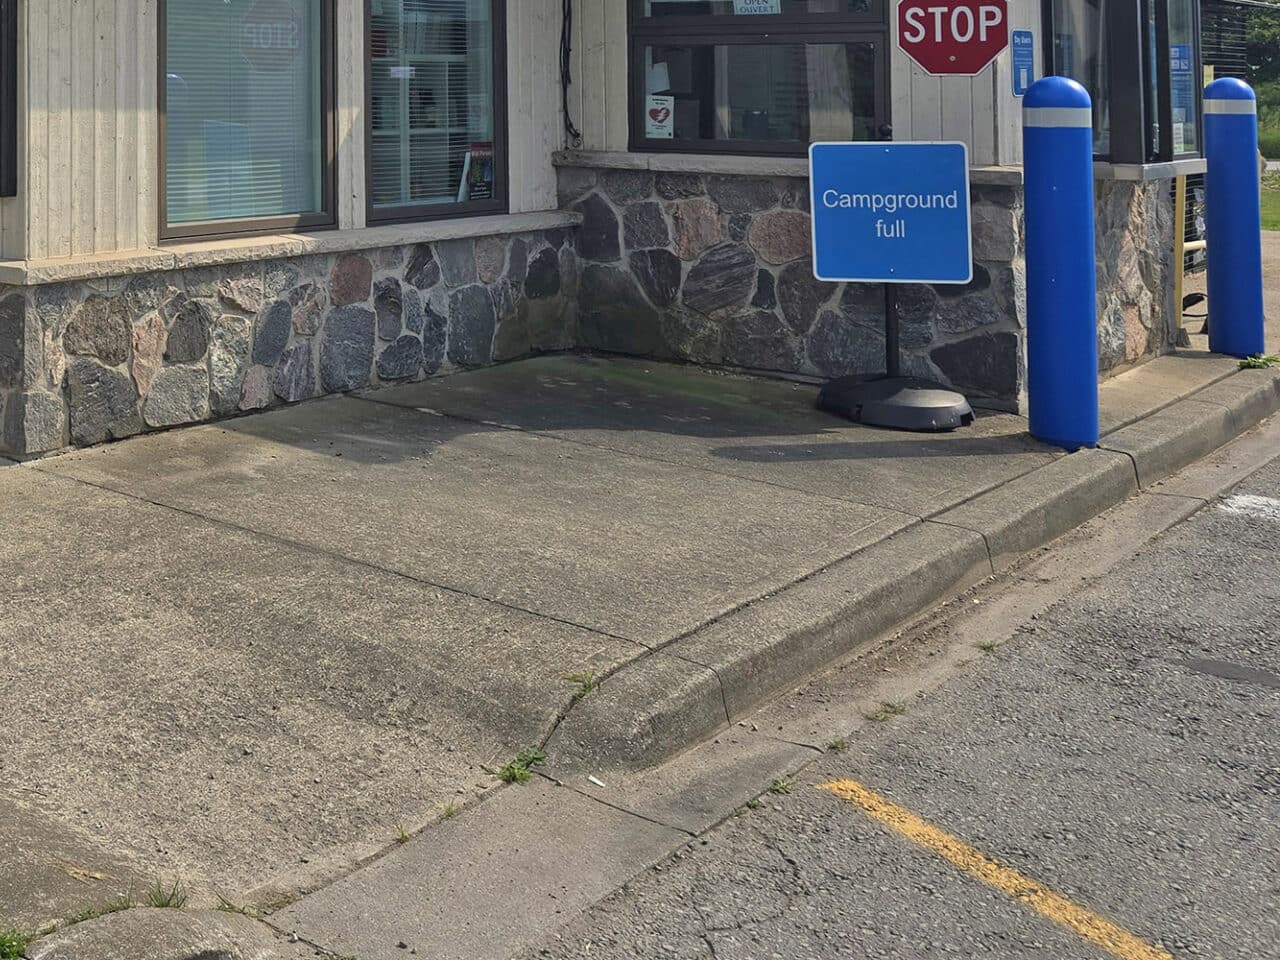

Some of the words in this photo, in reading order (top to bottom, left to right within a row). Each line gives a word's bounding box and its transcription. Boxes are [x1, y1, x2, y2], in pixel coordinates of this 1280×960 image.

[904, 5, 1003, 43] STOP
[823, 189, 958, 213] Campground
[875, 219, 906, 238] full
